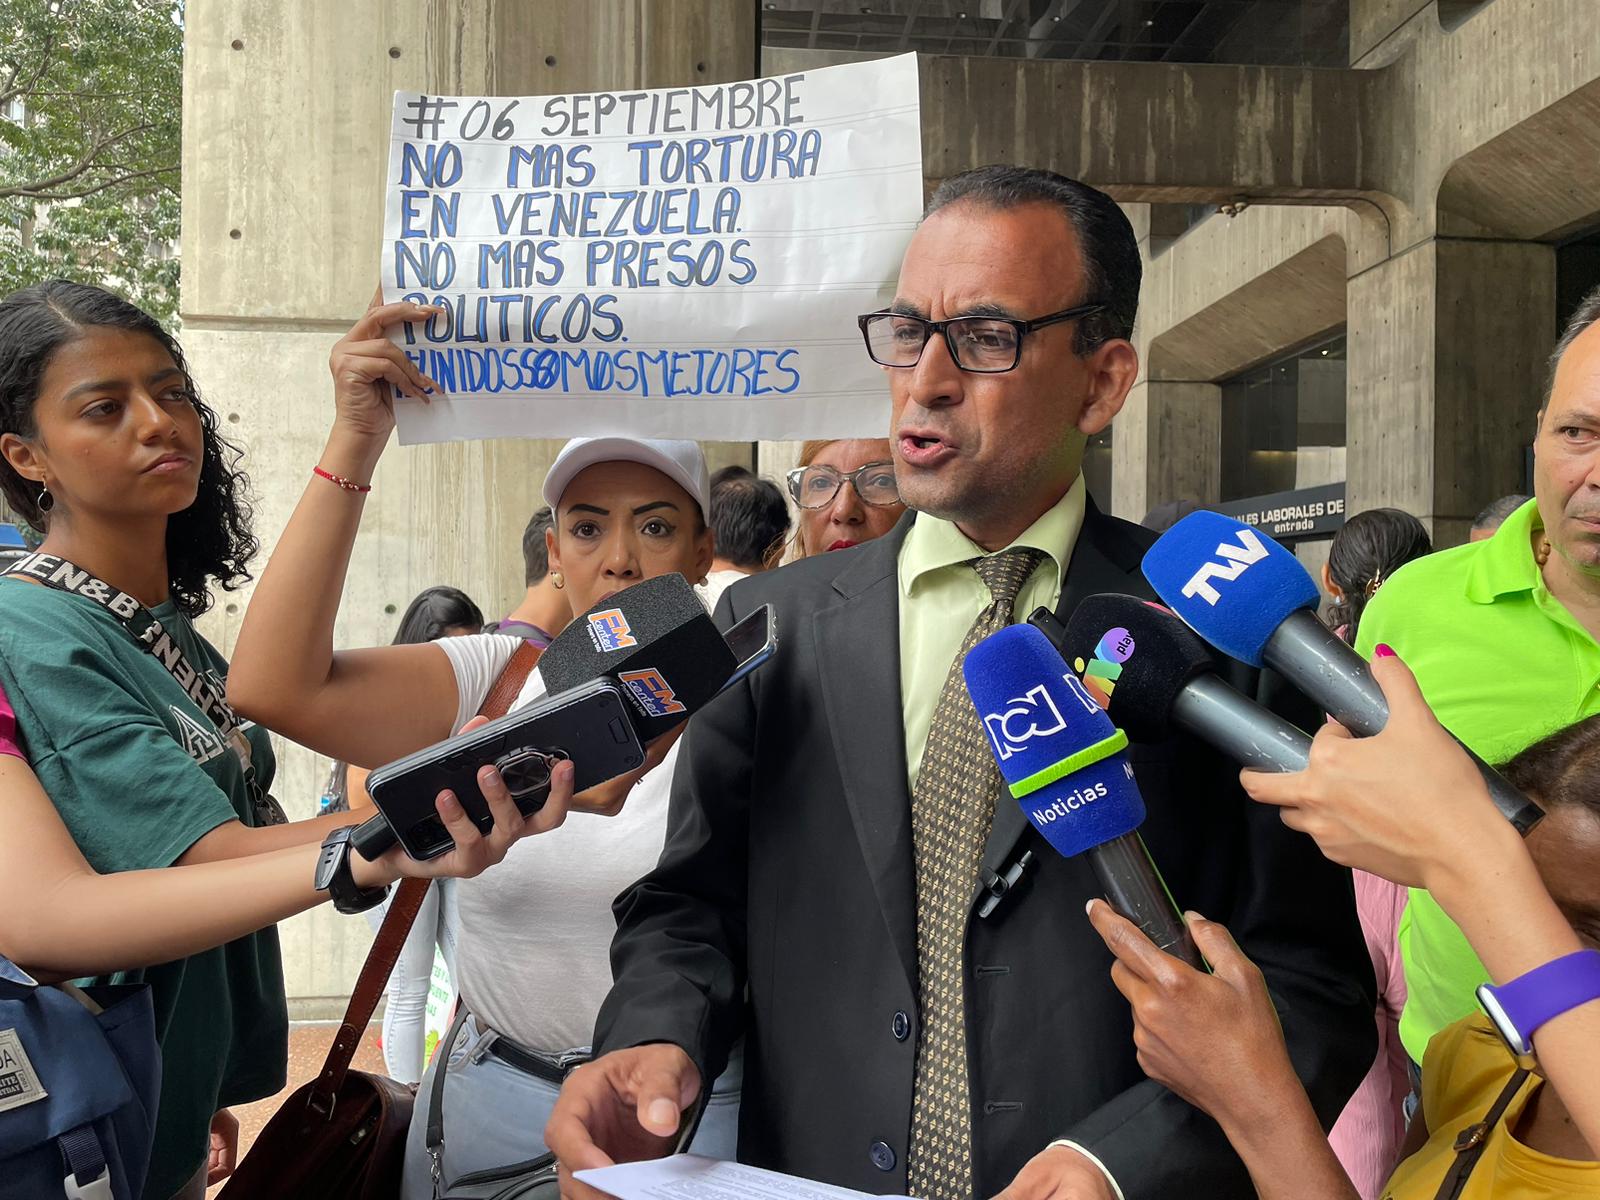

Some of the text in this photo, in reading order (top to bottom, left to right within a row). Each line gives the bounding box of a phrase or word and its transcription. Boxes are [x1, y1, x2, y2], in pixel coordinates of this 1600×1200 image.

[403, 74, 805, 140] #06 SEPTIEMBRE
[399, 129, 822, 188] NO MAS TORTURA
[400, 186, 742, 239] EN VENEZUELA.
[395, 238, 757, 290] NO MAS PRESOS
[1261, 503, 1324, 523] LABORALES
[1327, 500, 1344, 514] DE
[1275, 519, 1314, 533] entrada
[589, 609, 637, 647] FM
[594, 620, 613, 650] center
[619, 668, 686, 713] FM
[629, 680, 660, 714] center
[1033, 782, 1108, 826] Noticias
